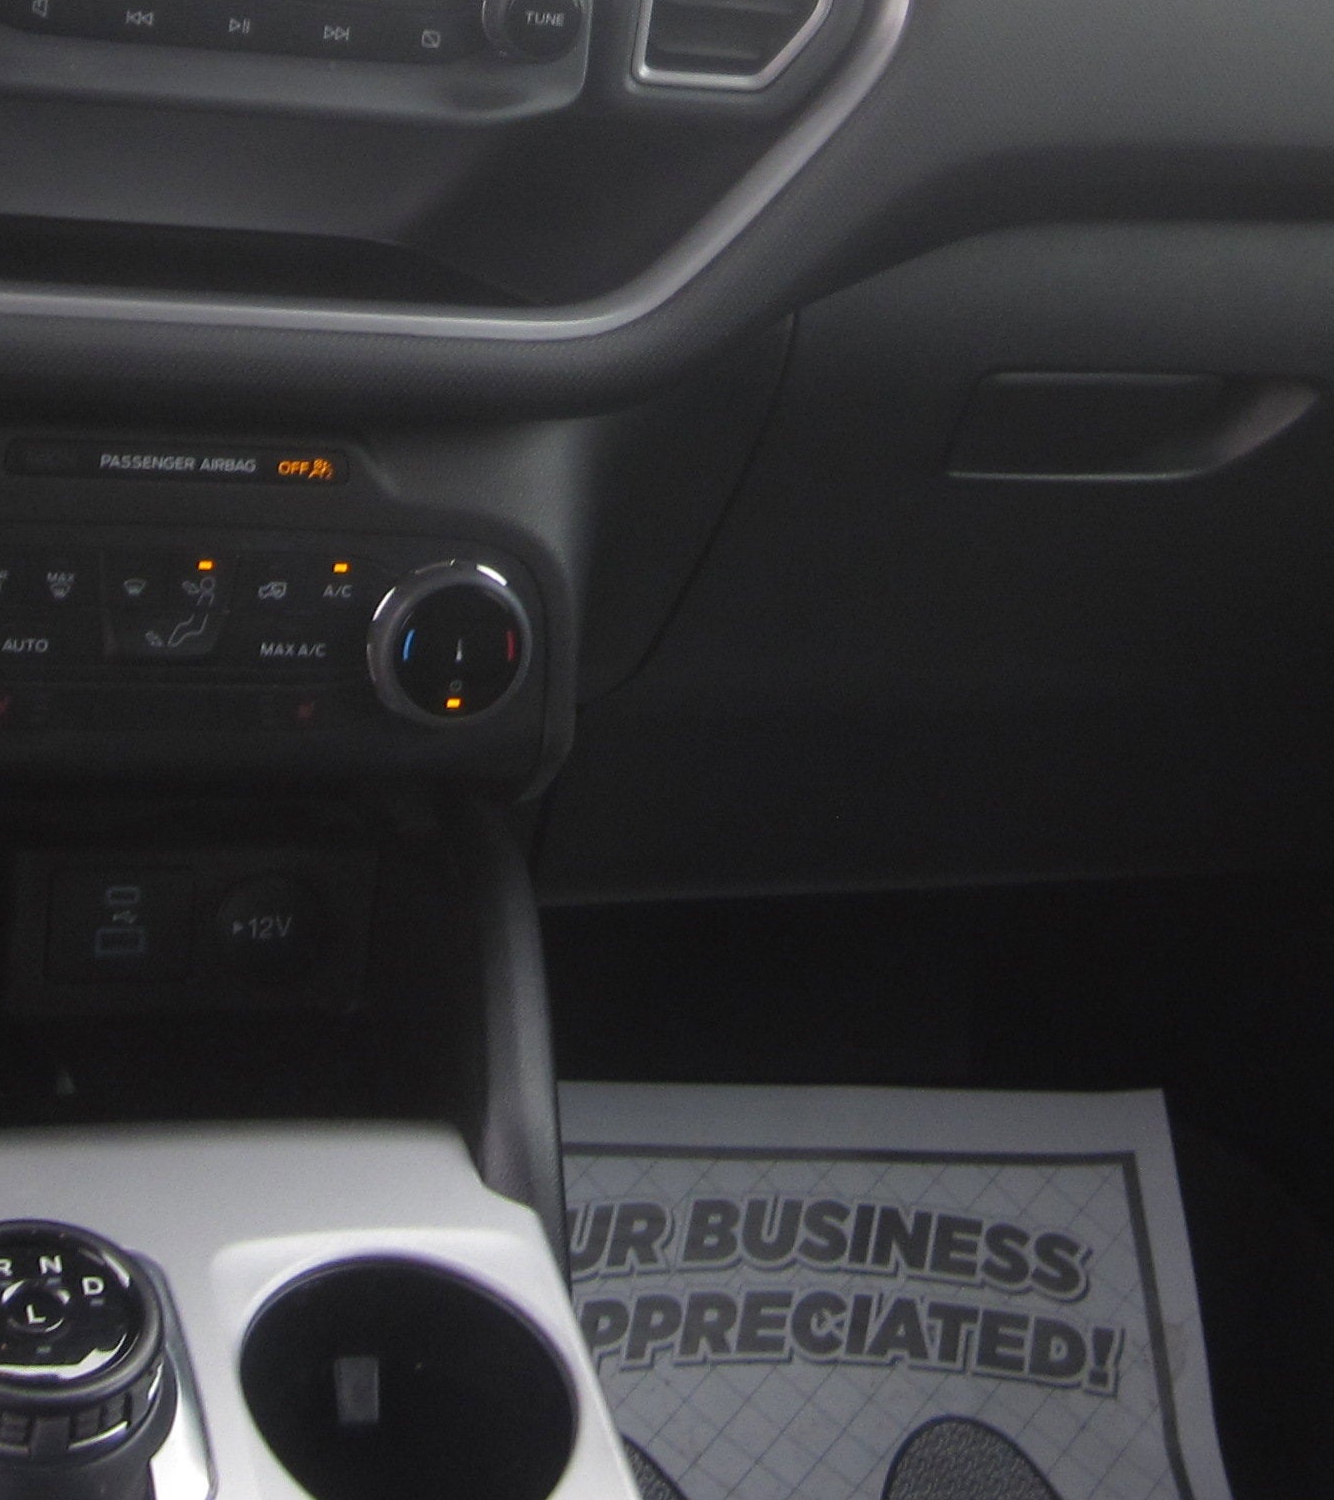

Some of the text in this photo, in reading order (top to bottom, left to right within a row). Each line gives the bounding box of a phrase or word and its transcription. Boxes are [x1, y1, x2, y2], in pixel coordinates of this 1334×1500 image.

[526, 10, 565, 27] TUNE
[99, 453, 310, 477] PASSENGER AIRBAG OFF
[46, 571, 75, 584] MAX
[322, 583, 353, 599] A/C
[1, 637, 49, 654] AUTO
[259, 641, 327, 658] MAX A/C
[682, 1199, 1084, 1294] BUSINESS
[38, 1254, 64, 1276] N
[81, 1275, 105, 1297] D
[25, 1302, 48, 1326] L
